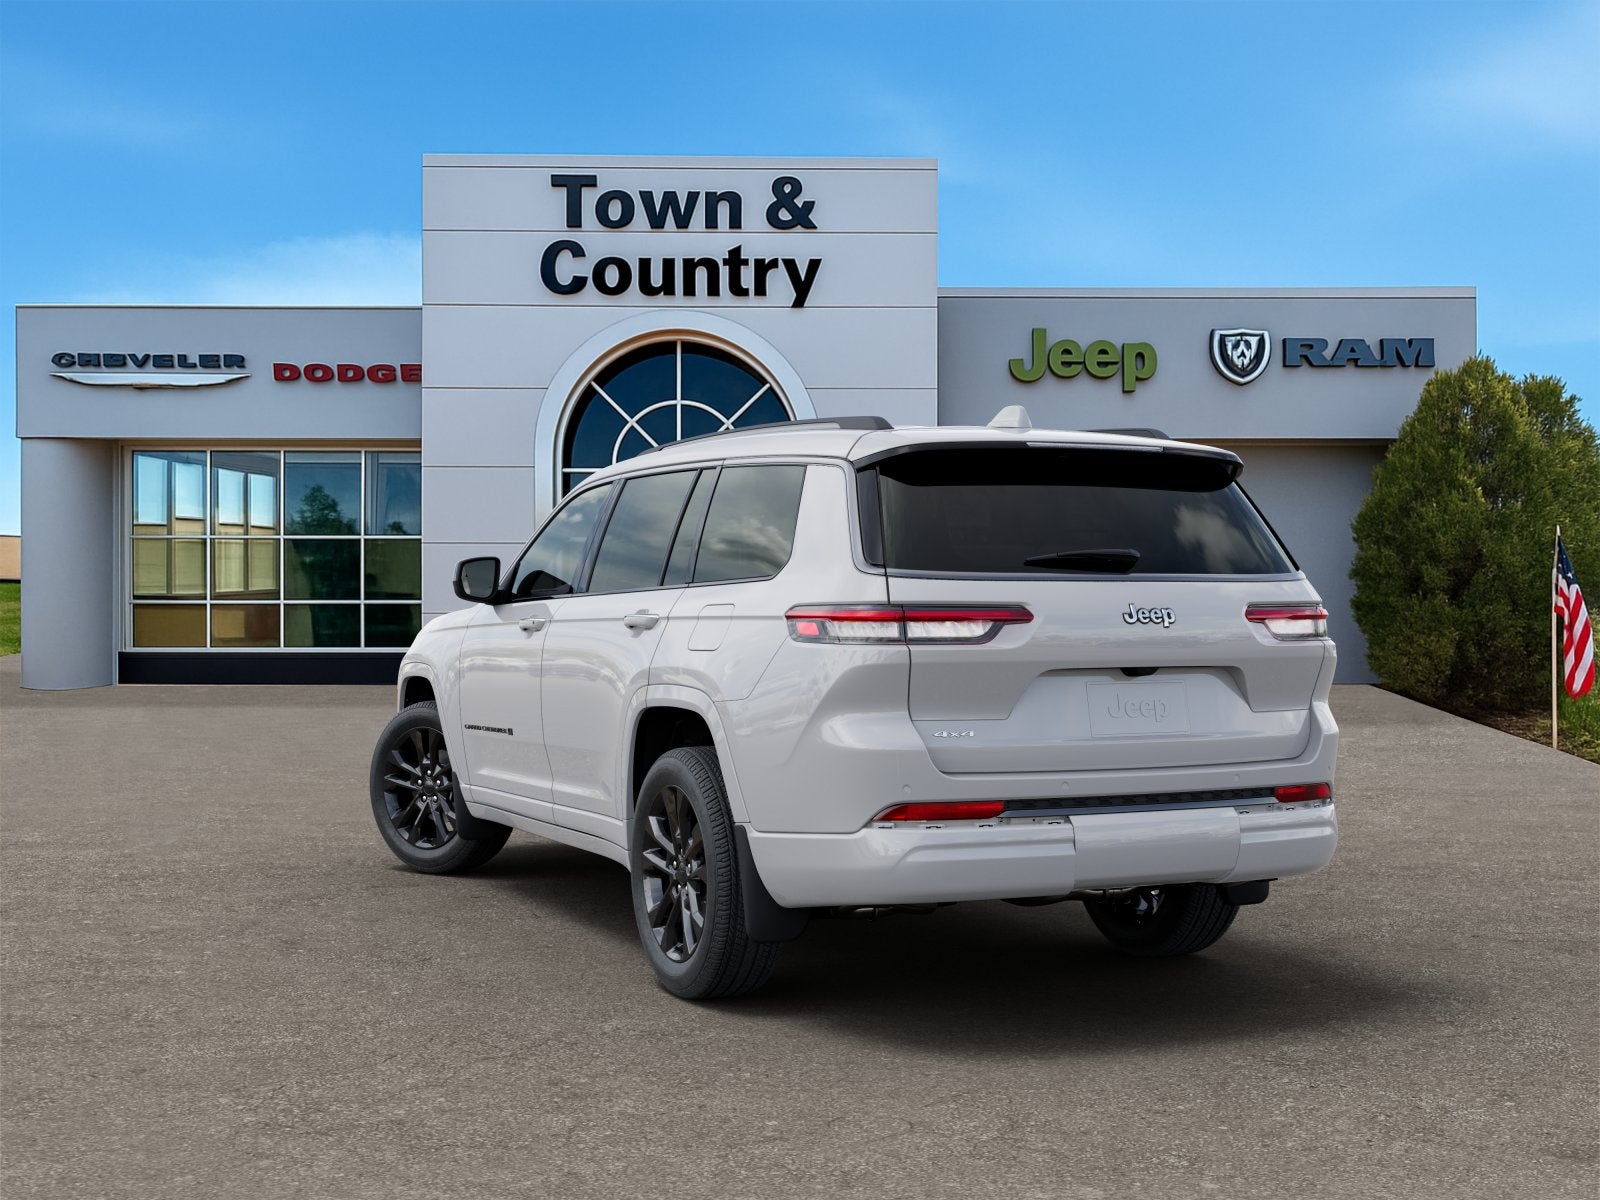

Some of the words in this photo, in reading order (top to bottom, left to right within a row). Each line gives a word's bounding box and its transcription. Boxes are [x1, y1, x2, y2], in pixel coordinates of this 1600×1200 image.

[550, 174, 743, 229] Town
[765, 176, 818, 230] &
[540, 239, 822, 308] Country
[1009, 327, 1157, 392] Jeep
[1282, 337, 1435, 367] RAM
[273, 363, 422, 383] DODGE
[1122, 603, 1176, 628] Jeep
[1107, 691, 1168, 723] Jeep
